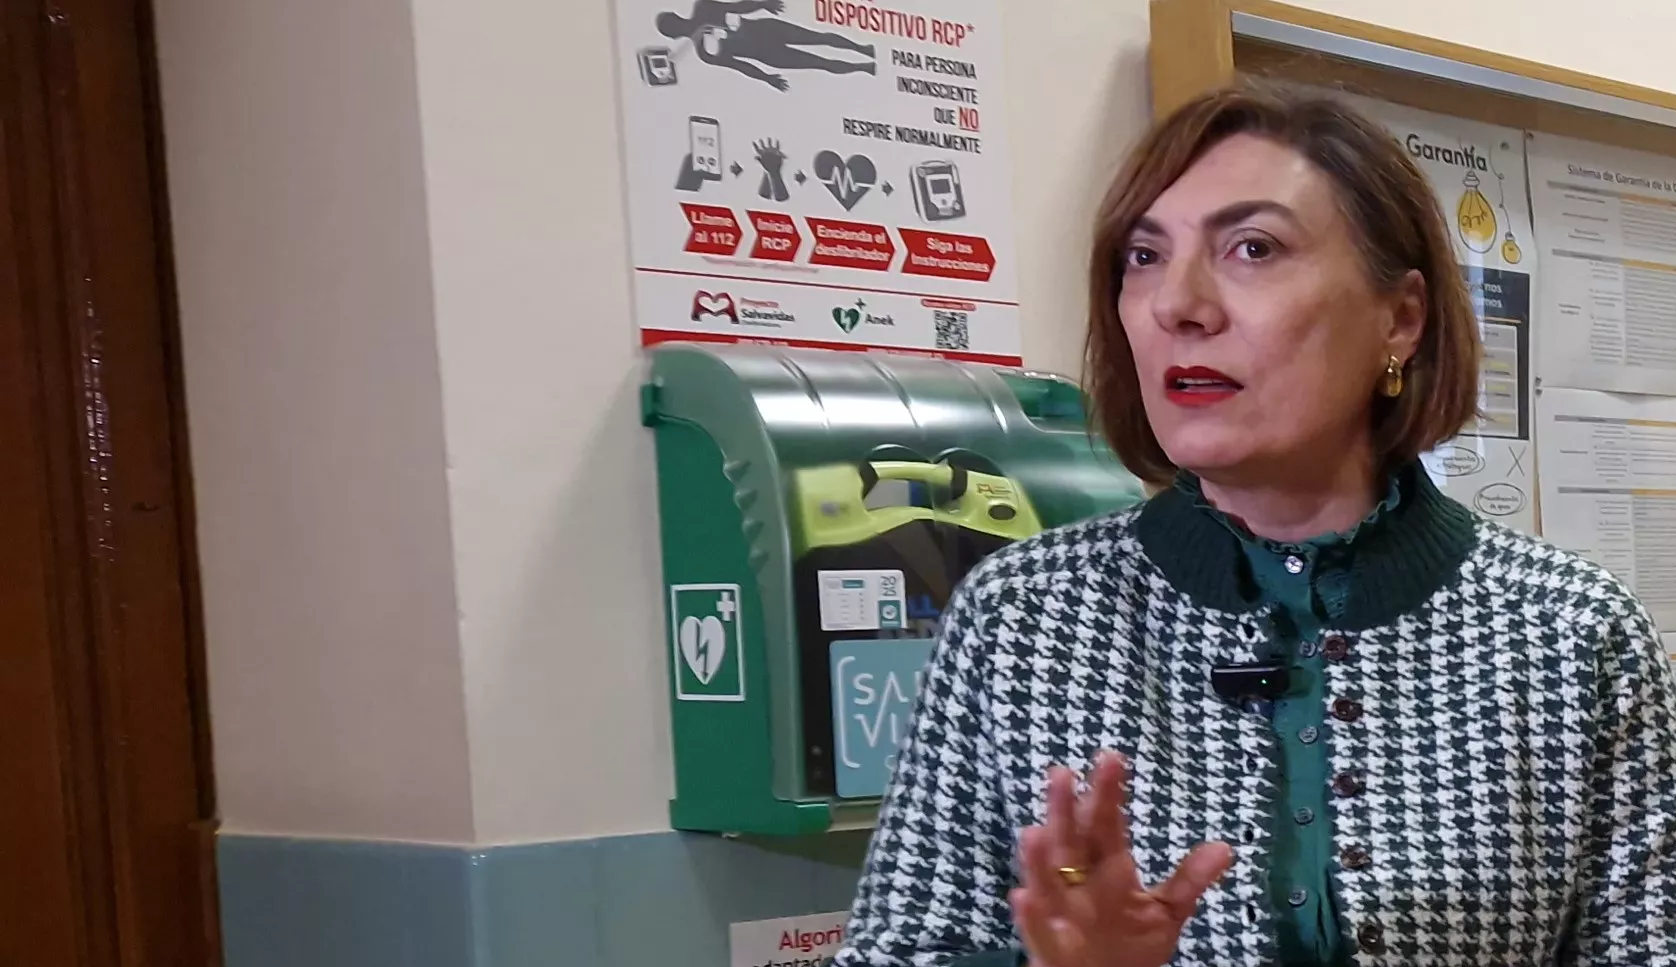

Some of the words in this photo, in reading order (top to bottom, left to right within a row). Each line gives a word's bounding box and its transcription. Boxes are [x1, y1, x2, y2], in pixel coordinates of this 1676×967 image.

[815, 0, 926, 40] DISPOSITIVO
[891, 49, 923, 71] PARA
[924, 54, 978, 80] PERSONA
[896, 75, 978, 105] INCONSCIENTE
[933, 106, 956, 126] QUE
[959, 105, 979, 130] NO
[842, 117, 892, 141] RESPIRE
[894, 126, 982, 154] NORMALMENTE
[1406, 133, 1488, 172] Garantía
[1603, 169, 1614, 183] de
[694, 230, 708, 243] al
[711, 231, 735, 247] 112
[761, 236, 792, 251] RCP
[865, 312, 895, 327] Anek
[779, 924, 846, 953] Algori
